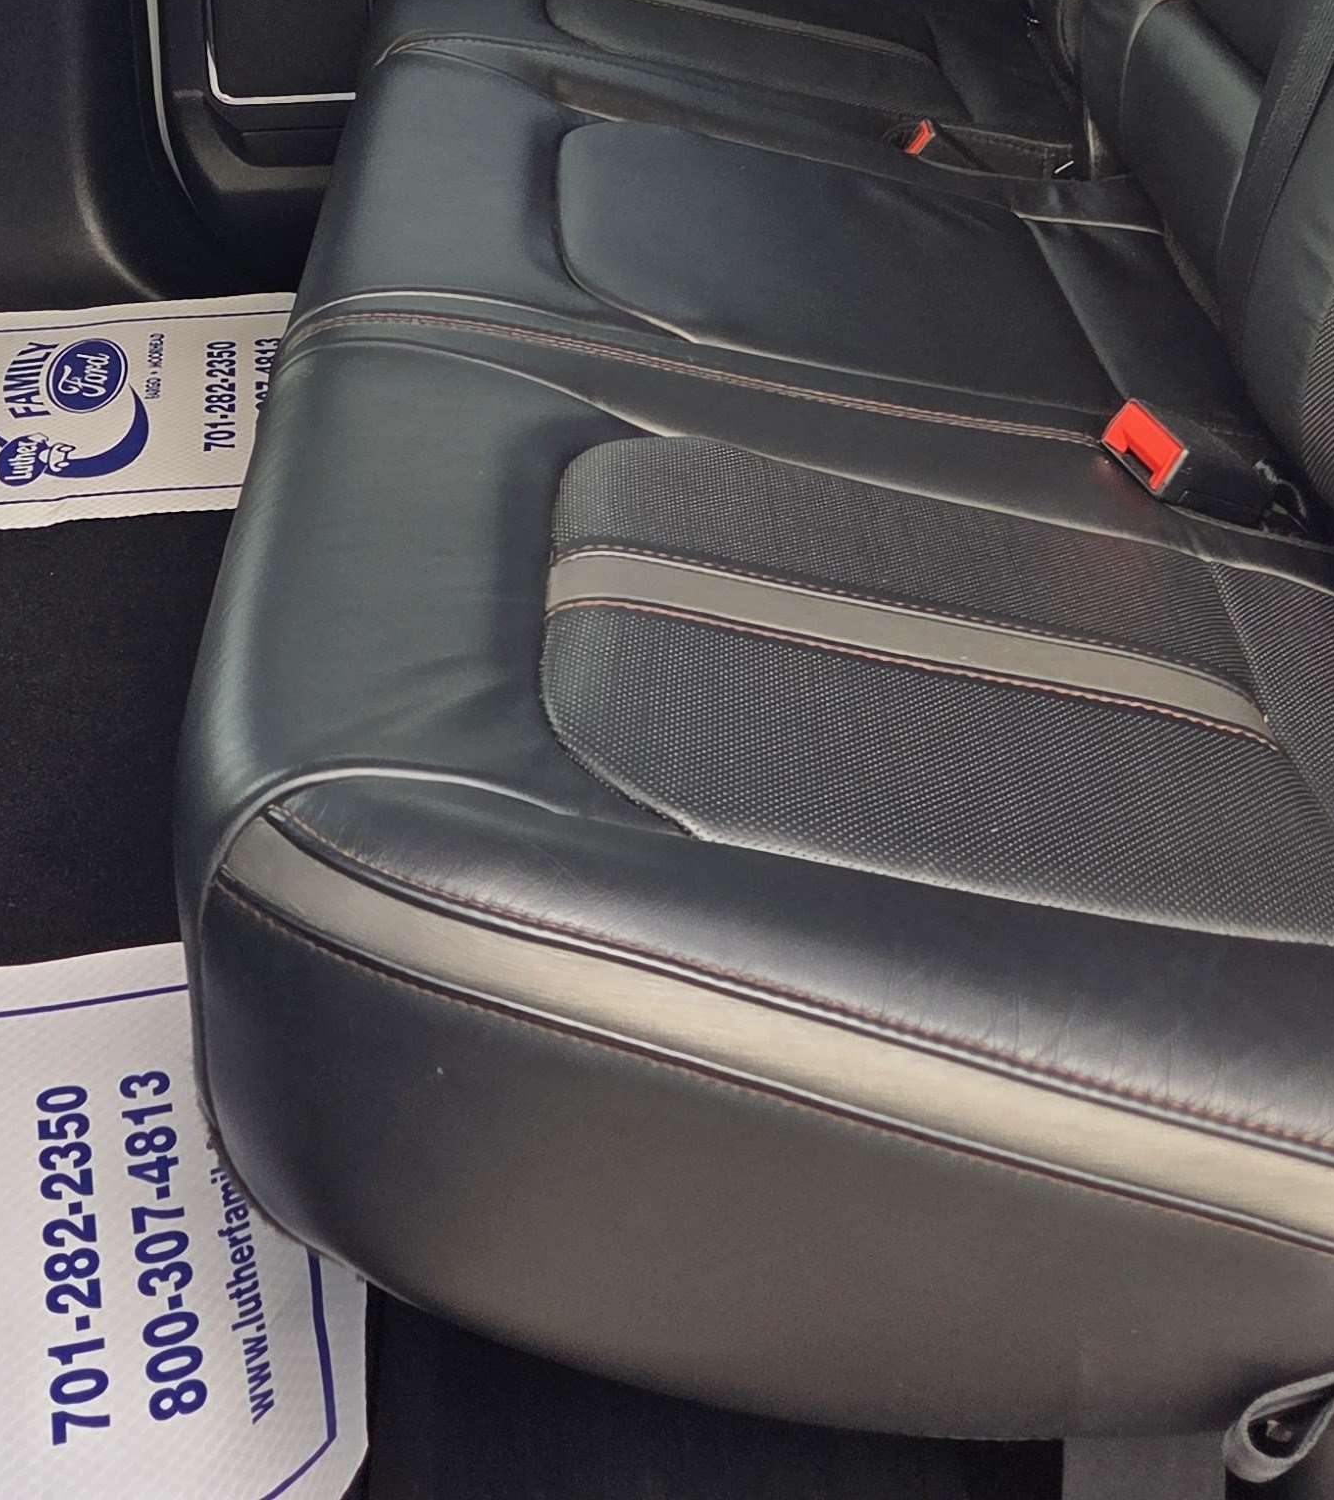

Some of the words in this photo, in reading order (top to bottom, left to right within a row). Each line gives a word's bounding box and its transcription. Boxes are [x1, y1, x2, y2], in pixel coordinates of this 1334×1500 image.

[1, 340, 60, 420] FAMILY
[58, 350, 111, 398] Ford
[203, 341, 236, 452] 701-282-2350
[4, 438, 36, 482] Luther
[37, 1085, 111, 1446] 701-282-2350
[119, 1069, 209, 1423] 800-307-4813
